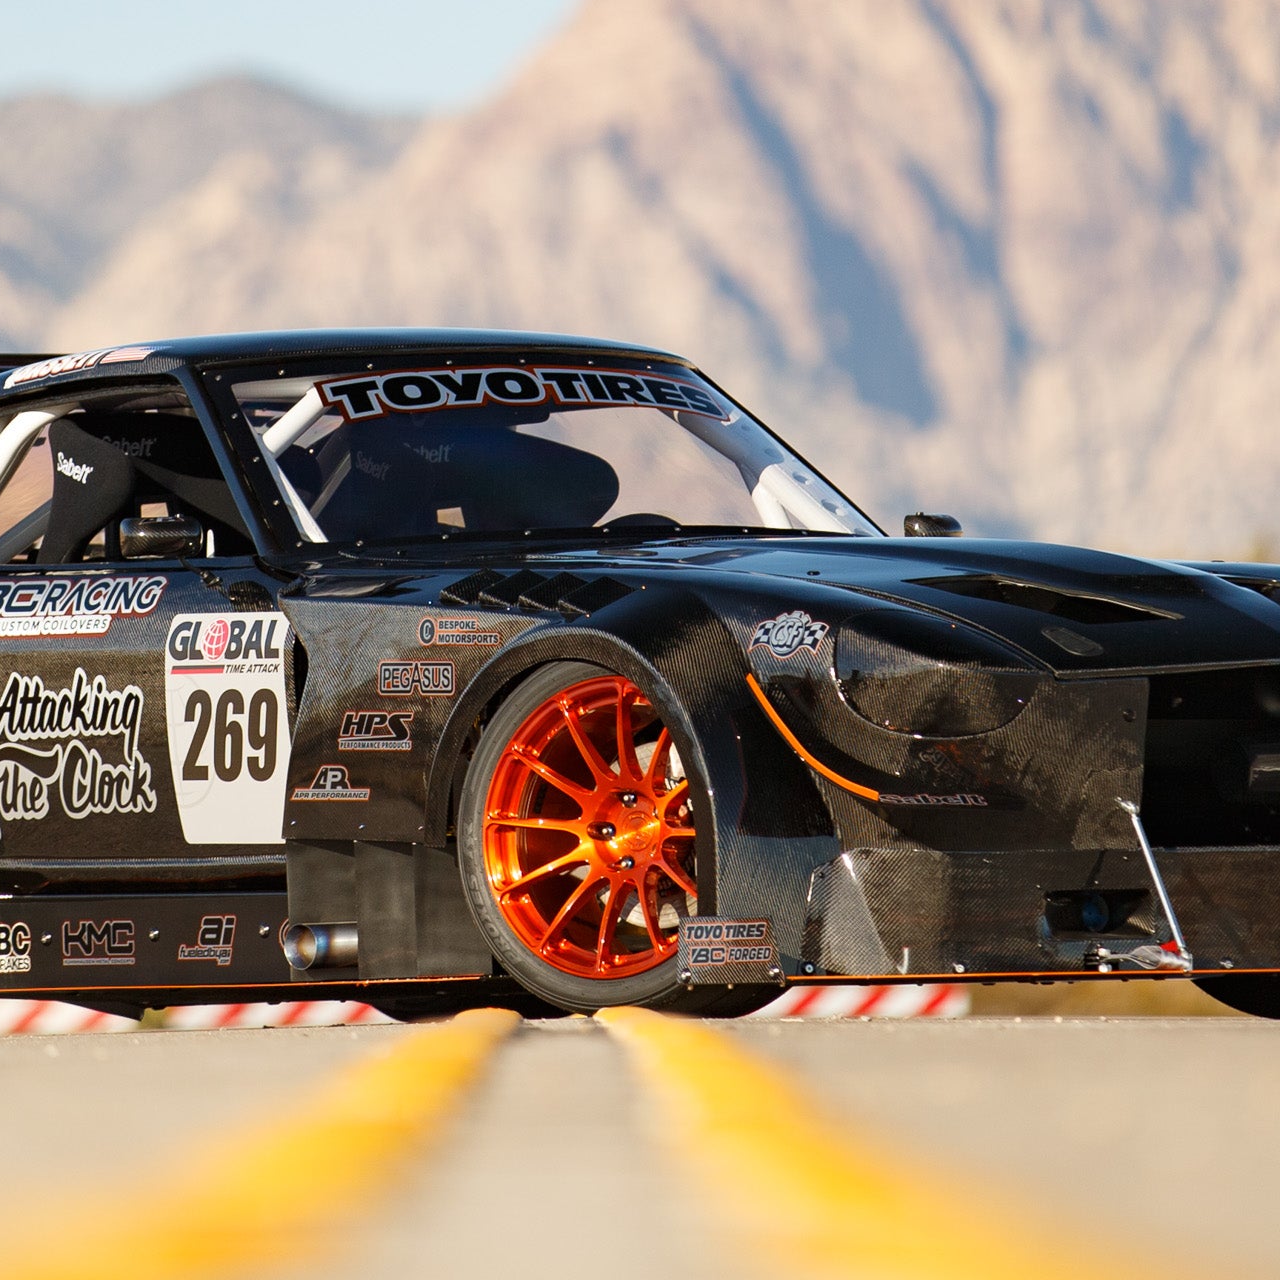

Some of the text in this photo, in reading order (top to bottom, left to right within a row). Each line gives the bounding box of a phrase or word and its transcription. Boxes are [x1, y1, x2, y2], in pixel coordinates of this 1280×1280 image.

[331, 371, 723, 415] TOYO TIRES
[56, 451, 93, 484] Sabelt
[43, 617, 109, 631] COILOVERS
[438, 620, 476, 630] BESPOKE
[771, 620, 803, 648] CSF
[168, 619, 280, 660] GLOBAL
[438, 633, 499, 644] MOTORSPORTS
[225, 663, 281, 674] TIME ATTACK
[382, 662, 450, 690] PEGASUS
[182, 688, 279, 782] 269
[340, 713, 413, 740] HPS
[340, 741, 411, 749] PERFORMANCE PRODUCTS
[62, 744, 156, 814] Clock
[879, 793, 988, 806] Sabelt
[63, 921, 135, 955] KMC
[199, 917, 235, 946] ai
[686, 923, 766, 939] TOYO TIRES
[728, 947, 772, 960] FORGED
